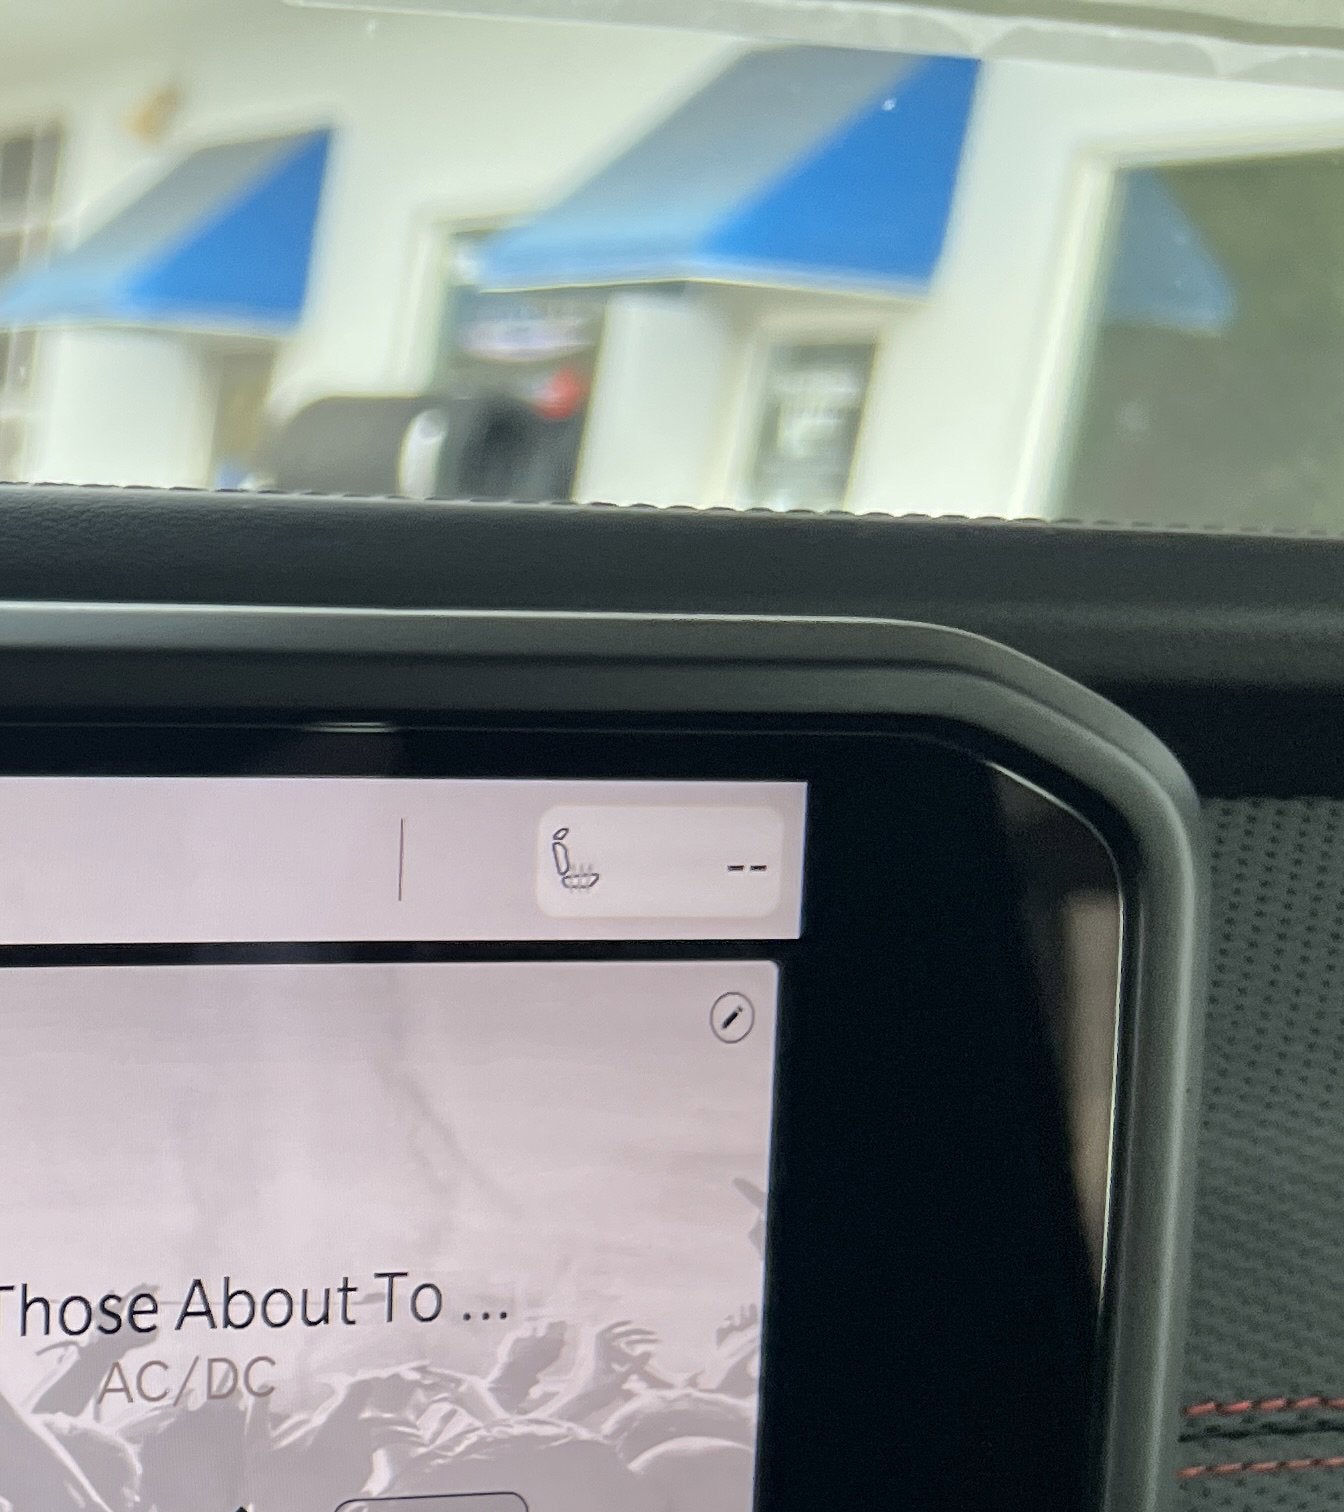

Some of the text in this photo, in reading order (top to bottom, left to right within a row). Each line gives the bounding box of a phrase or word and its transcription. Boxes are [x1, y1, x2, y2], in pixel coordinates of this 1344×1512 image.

[174, 1276, 358, 1331] About
[374, 1271, 443, 1323] To
[97, 1355, 278, 1406] AC/DC
